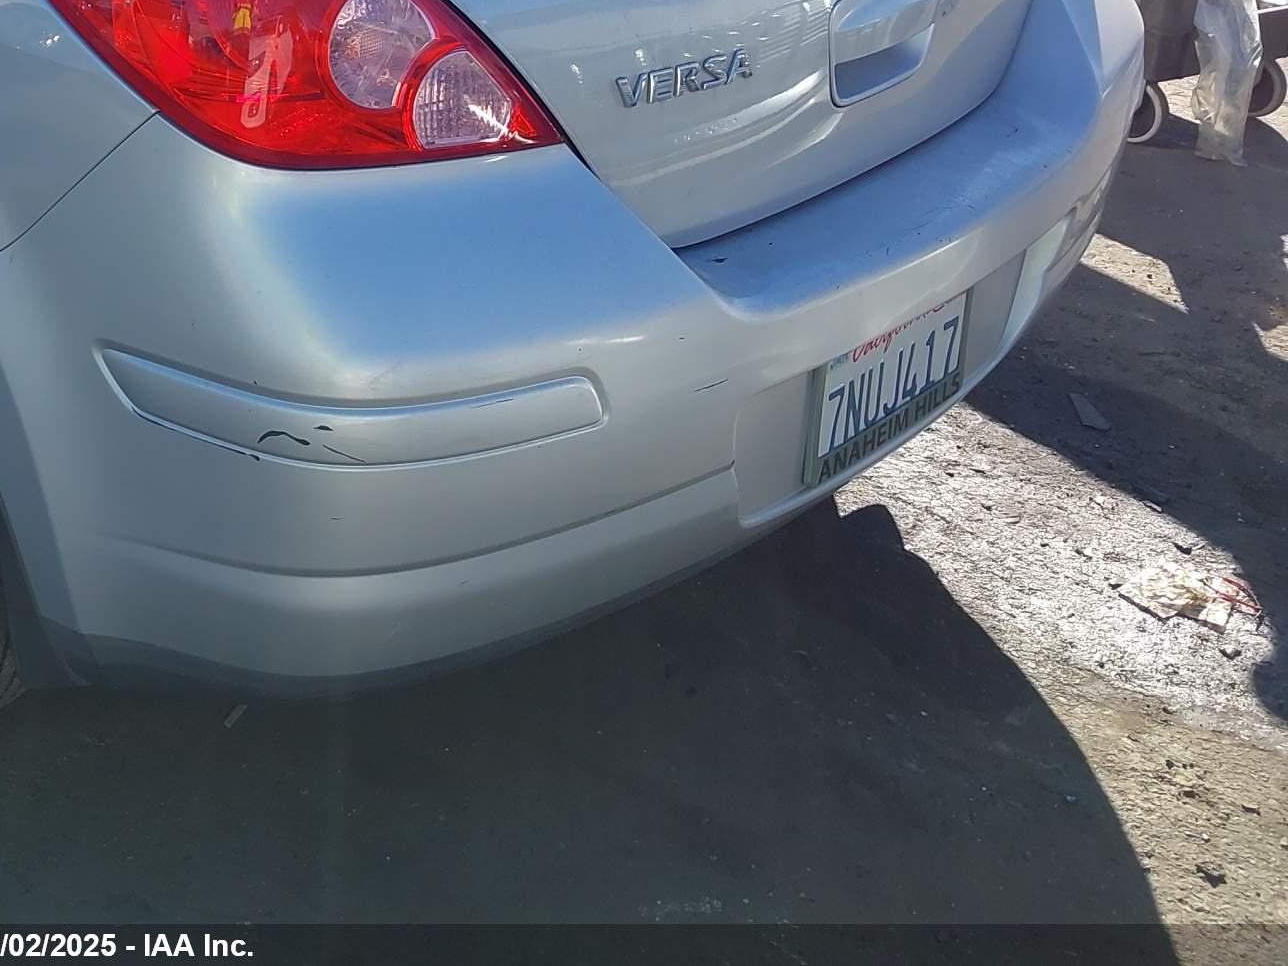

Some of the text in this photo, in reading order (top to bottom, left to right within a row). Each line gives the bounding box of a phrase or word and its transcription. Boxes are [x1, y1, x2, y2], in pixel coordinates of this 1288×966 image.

[615, 47, 753, 107] VERSA
[819, 372, 961, 483] ANAHEIM HILLS
[828, 315, 960, 451] 7NUJ417
